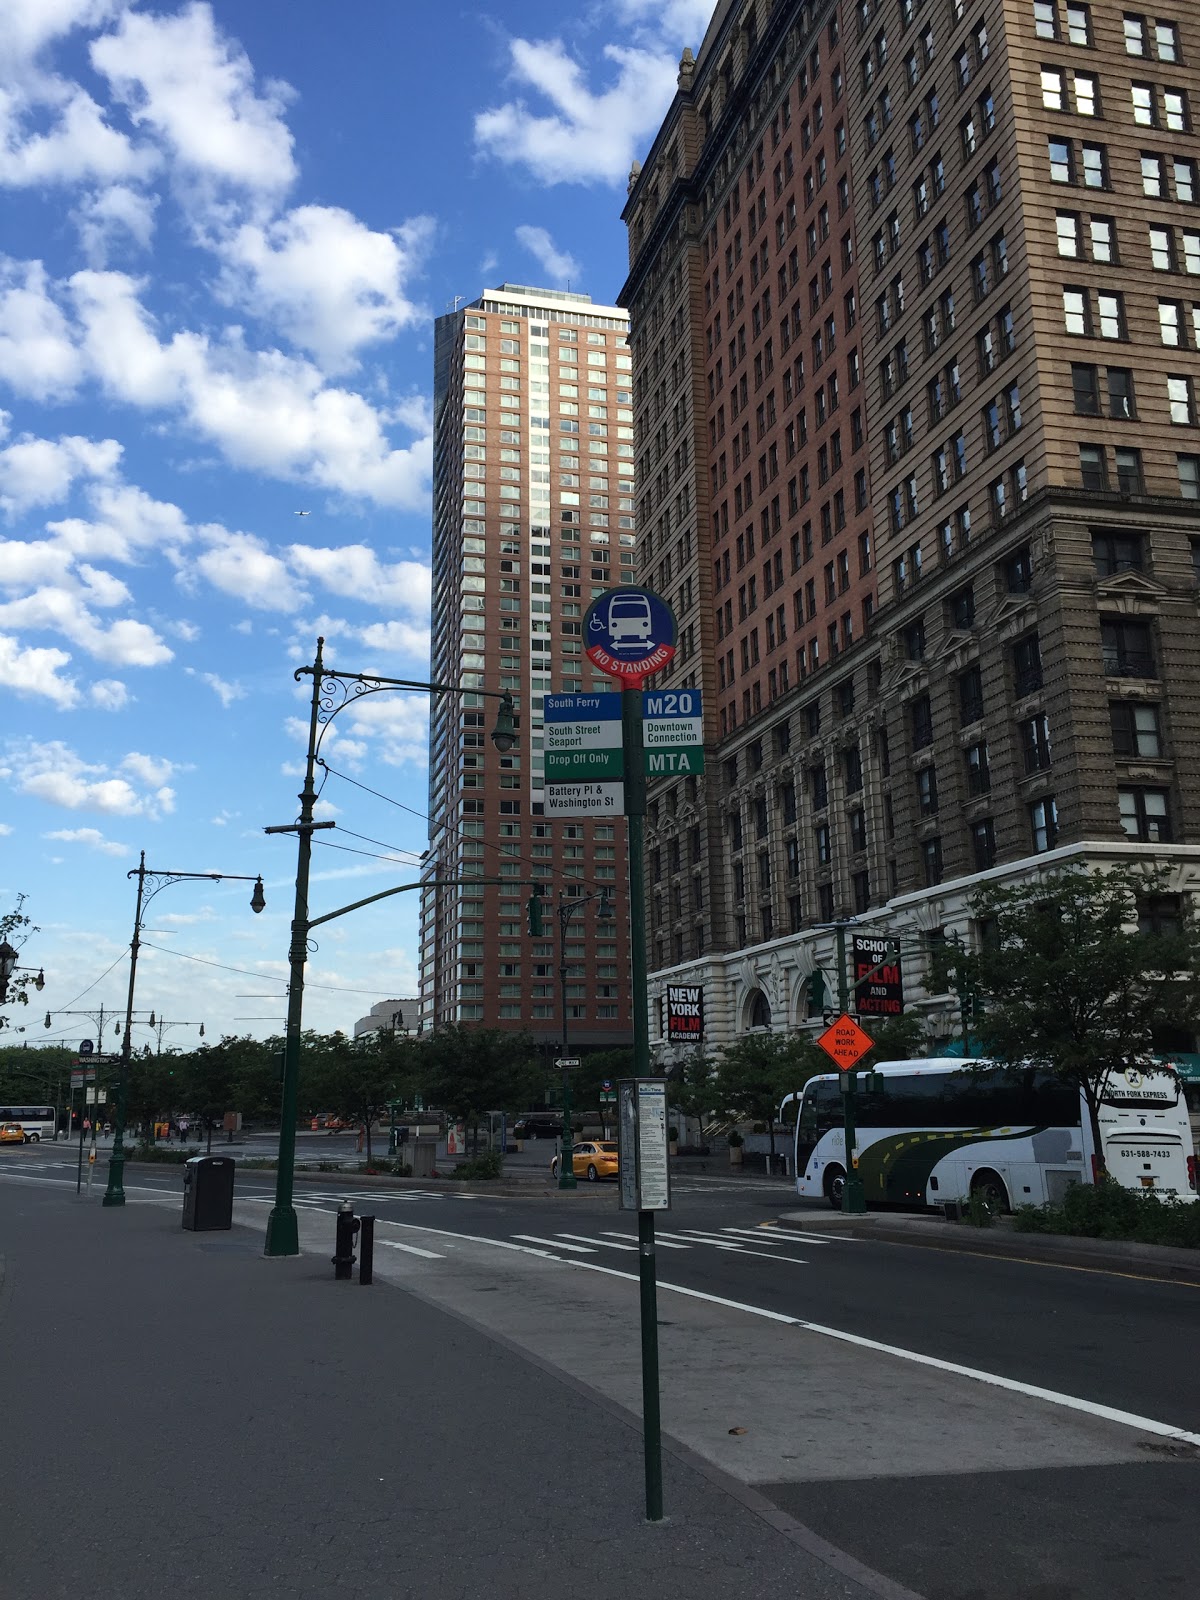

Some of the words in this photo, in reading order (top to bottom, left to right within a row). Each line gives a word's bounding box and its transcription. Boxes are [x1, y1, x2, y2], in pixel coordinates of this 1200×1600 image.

[593, 648, 609, 666] NO
[611, 648, 670, 674] STANDING
[548, 698, 574, 709] South
[577, 697, 600, 709] Ferry
[647, 693, 693, 715] M20
[548, 725, 574, 736] South
[575, 724, 601, 735] Street
[647, 722, 693, 733] Downtown
[548, 736, 582, 748] Seaport
[647, 732, 697, 743] Connection
[549, 754, 571, 766] Drop
[574, 753, 586, 764] Off
[588, 753, 609, 766] Only
[649, 753, 691, 771] MTA
[549, 785, 581, 798] Battery
[584, 785, 594, 795] Pl
[596, 785, 603, 795] &
[549, 796, 603, 809] Washington
[604, 795, 614, 807] St
[872, 953, 883, 964] OF
[858, 963, 899, 985] FILM
[669, 986, 700, 1003] NEW
[870, 986, 887, 996] AND
[670, 1002, 700, 1016] YORK
[858, 997, 901, 1013] ACTING
[669, 1016, 701, 1031] FILM
[670, 1031, 700, 1040] ACADEMY
[835, 1028, 856, 1037] ROAD
[835, 1038, 856, 1047] WORK
[833, 1048, 859, 1058] AHEAD
[1127, 1090, 1142, 1098] FORK
[1143, 1091, 1168, 1099] EXPRESS
[1121, 1150, 1171, 1158] 631-588-7433
